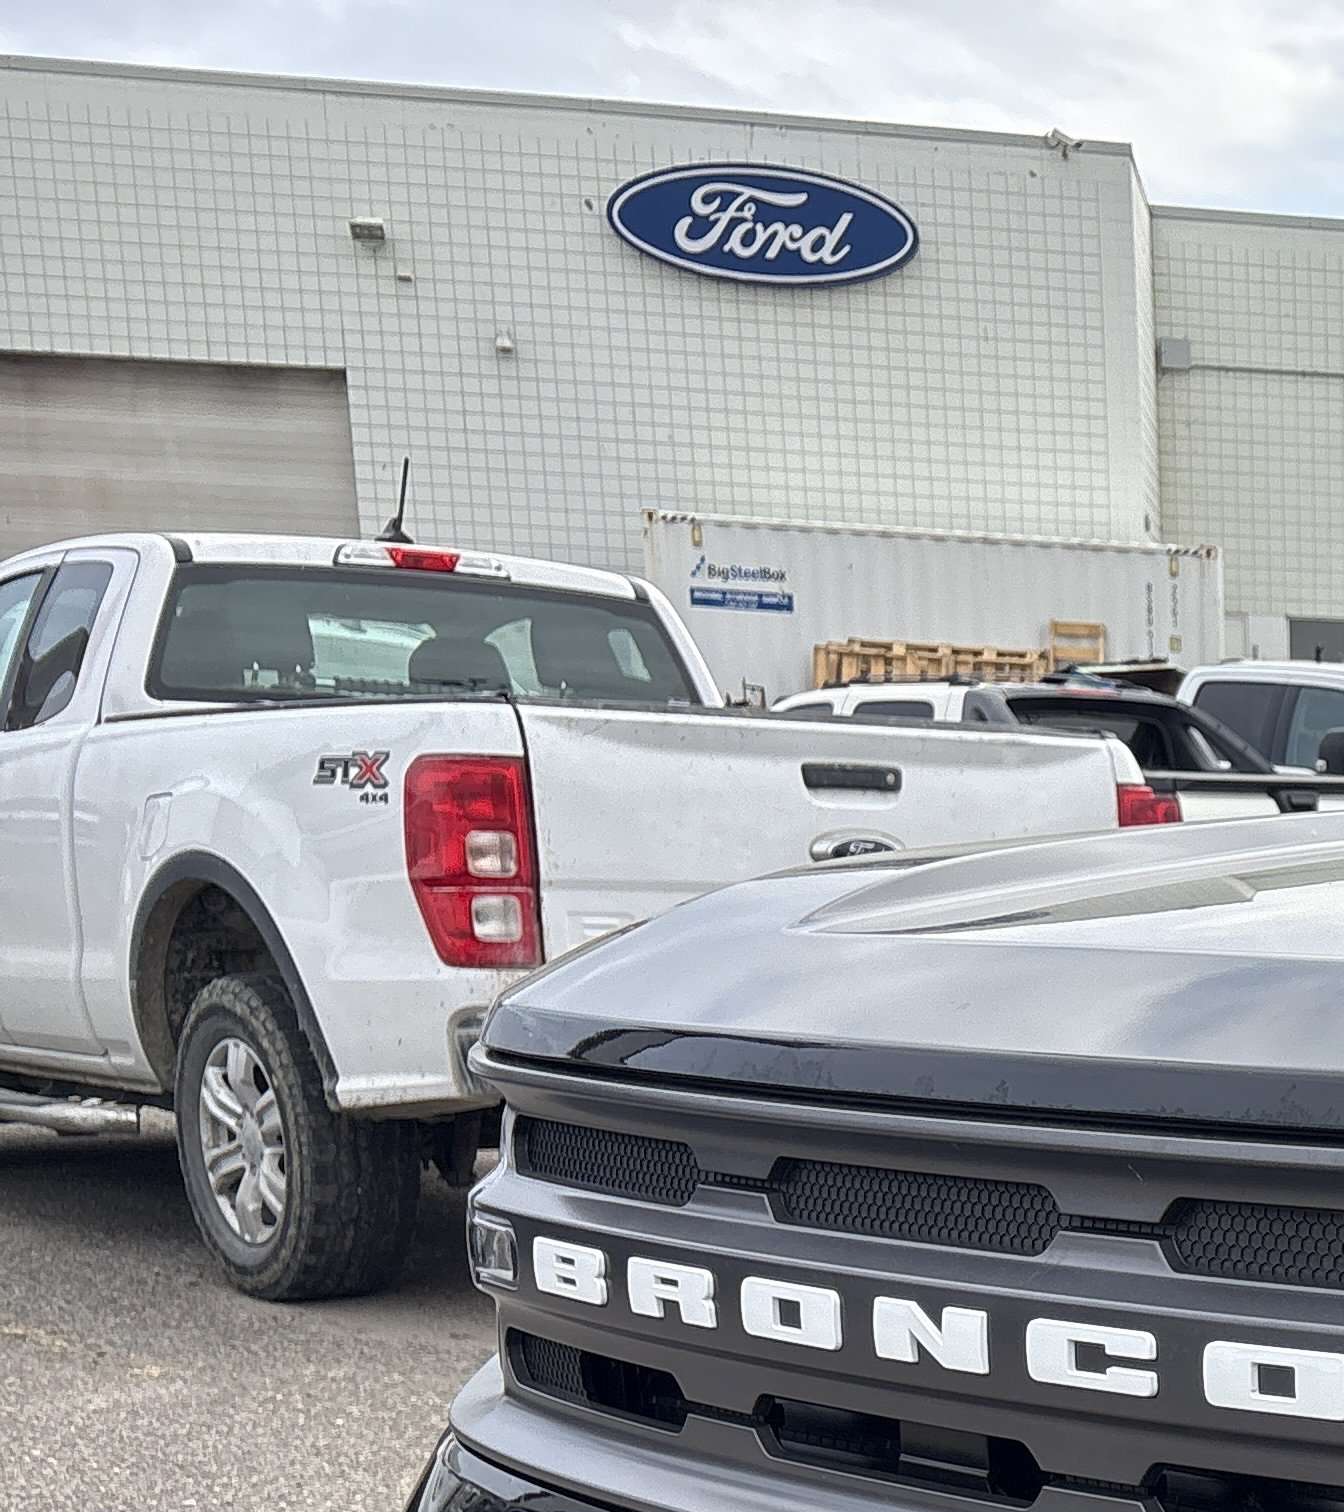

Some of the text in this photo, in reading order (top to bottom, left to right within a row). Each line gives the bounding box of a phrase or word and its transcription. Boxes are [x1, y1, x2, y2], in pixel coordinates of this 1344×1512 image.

[673, 182, 854, 265] Ford
[707, 564, 788, 582] BigSteelBox
[312, 750, 391, 789] STX
